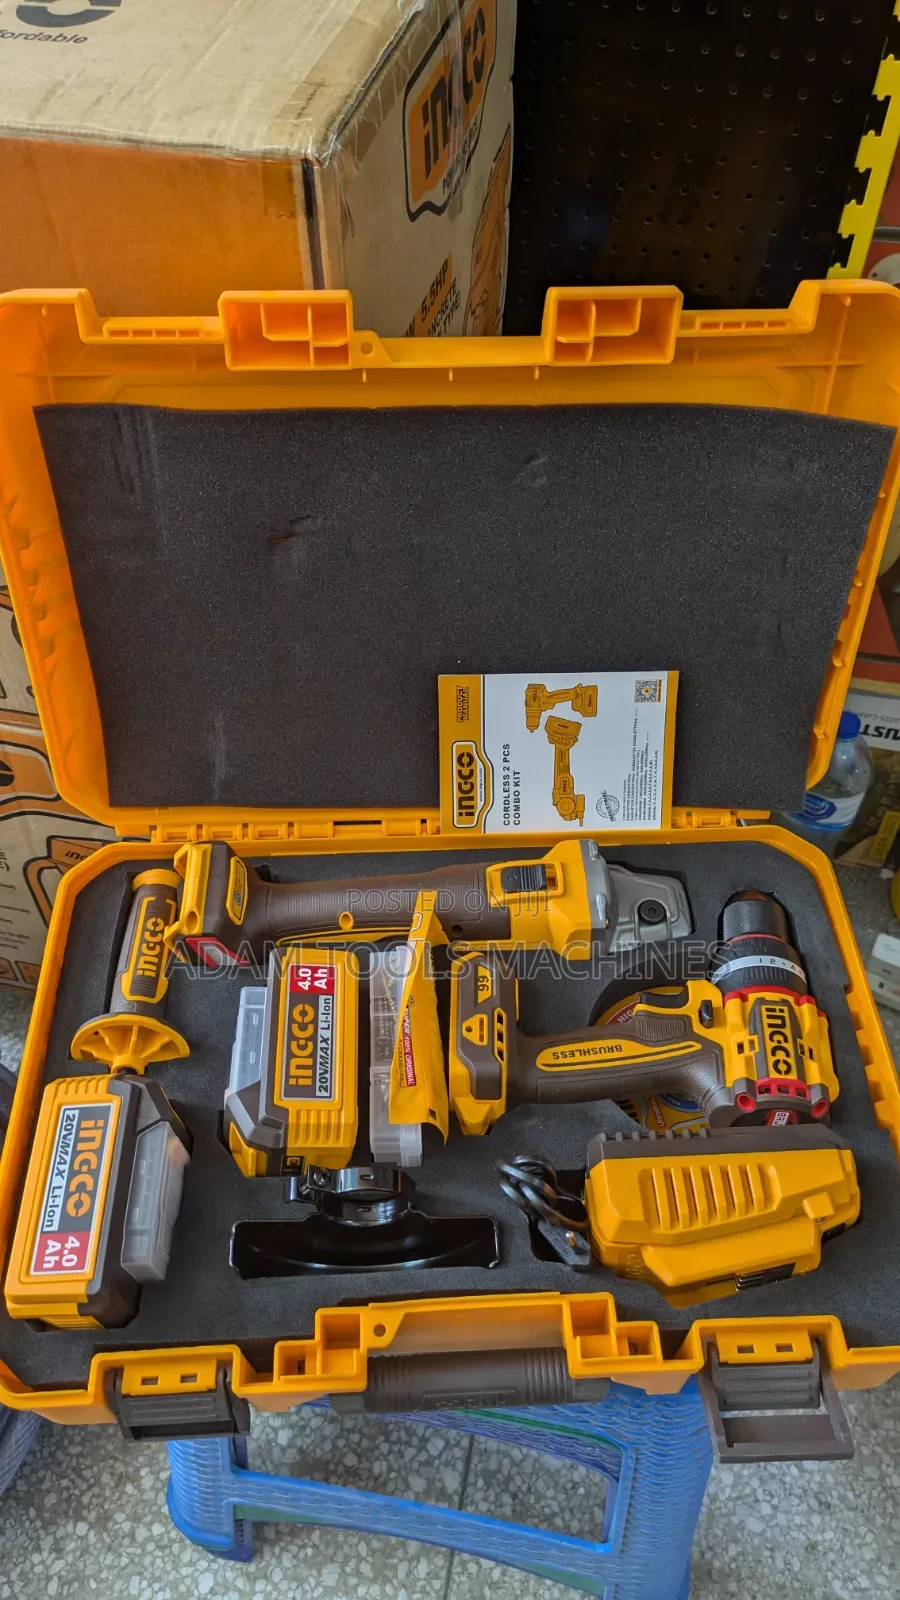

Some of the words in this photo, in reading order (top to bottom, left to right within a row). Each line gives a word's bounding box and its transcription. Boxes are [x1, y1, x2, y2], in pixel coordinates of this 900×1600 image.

[420, 258, 449, 323] 5.5HP
[456, 685, 464, 723] PRODUCT
[502, 744, 510, 763] PCS
[457, 752, 475, 817] INGCO
[513, 790, 521, 826] COMBO
[136, 917, 165, 978] INGCO
[297, 967, 312, 991] 4.0
[313, 968, 328, 989] Ah
[289, 1003, 315, 1086] INGCO
[551, 1043, 623, 1061] BRUSHLESS
[765, 1005, 792, 1076] INGCO
[405, 1054, 415, 1086] ORIGINAL
[67, 1119, 105, 1218] INGCO
[43, 1239, 62, 1269] Ah
[61, 1236, 81, 1267] 4.0
